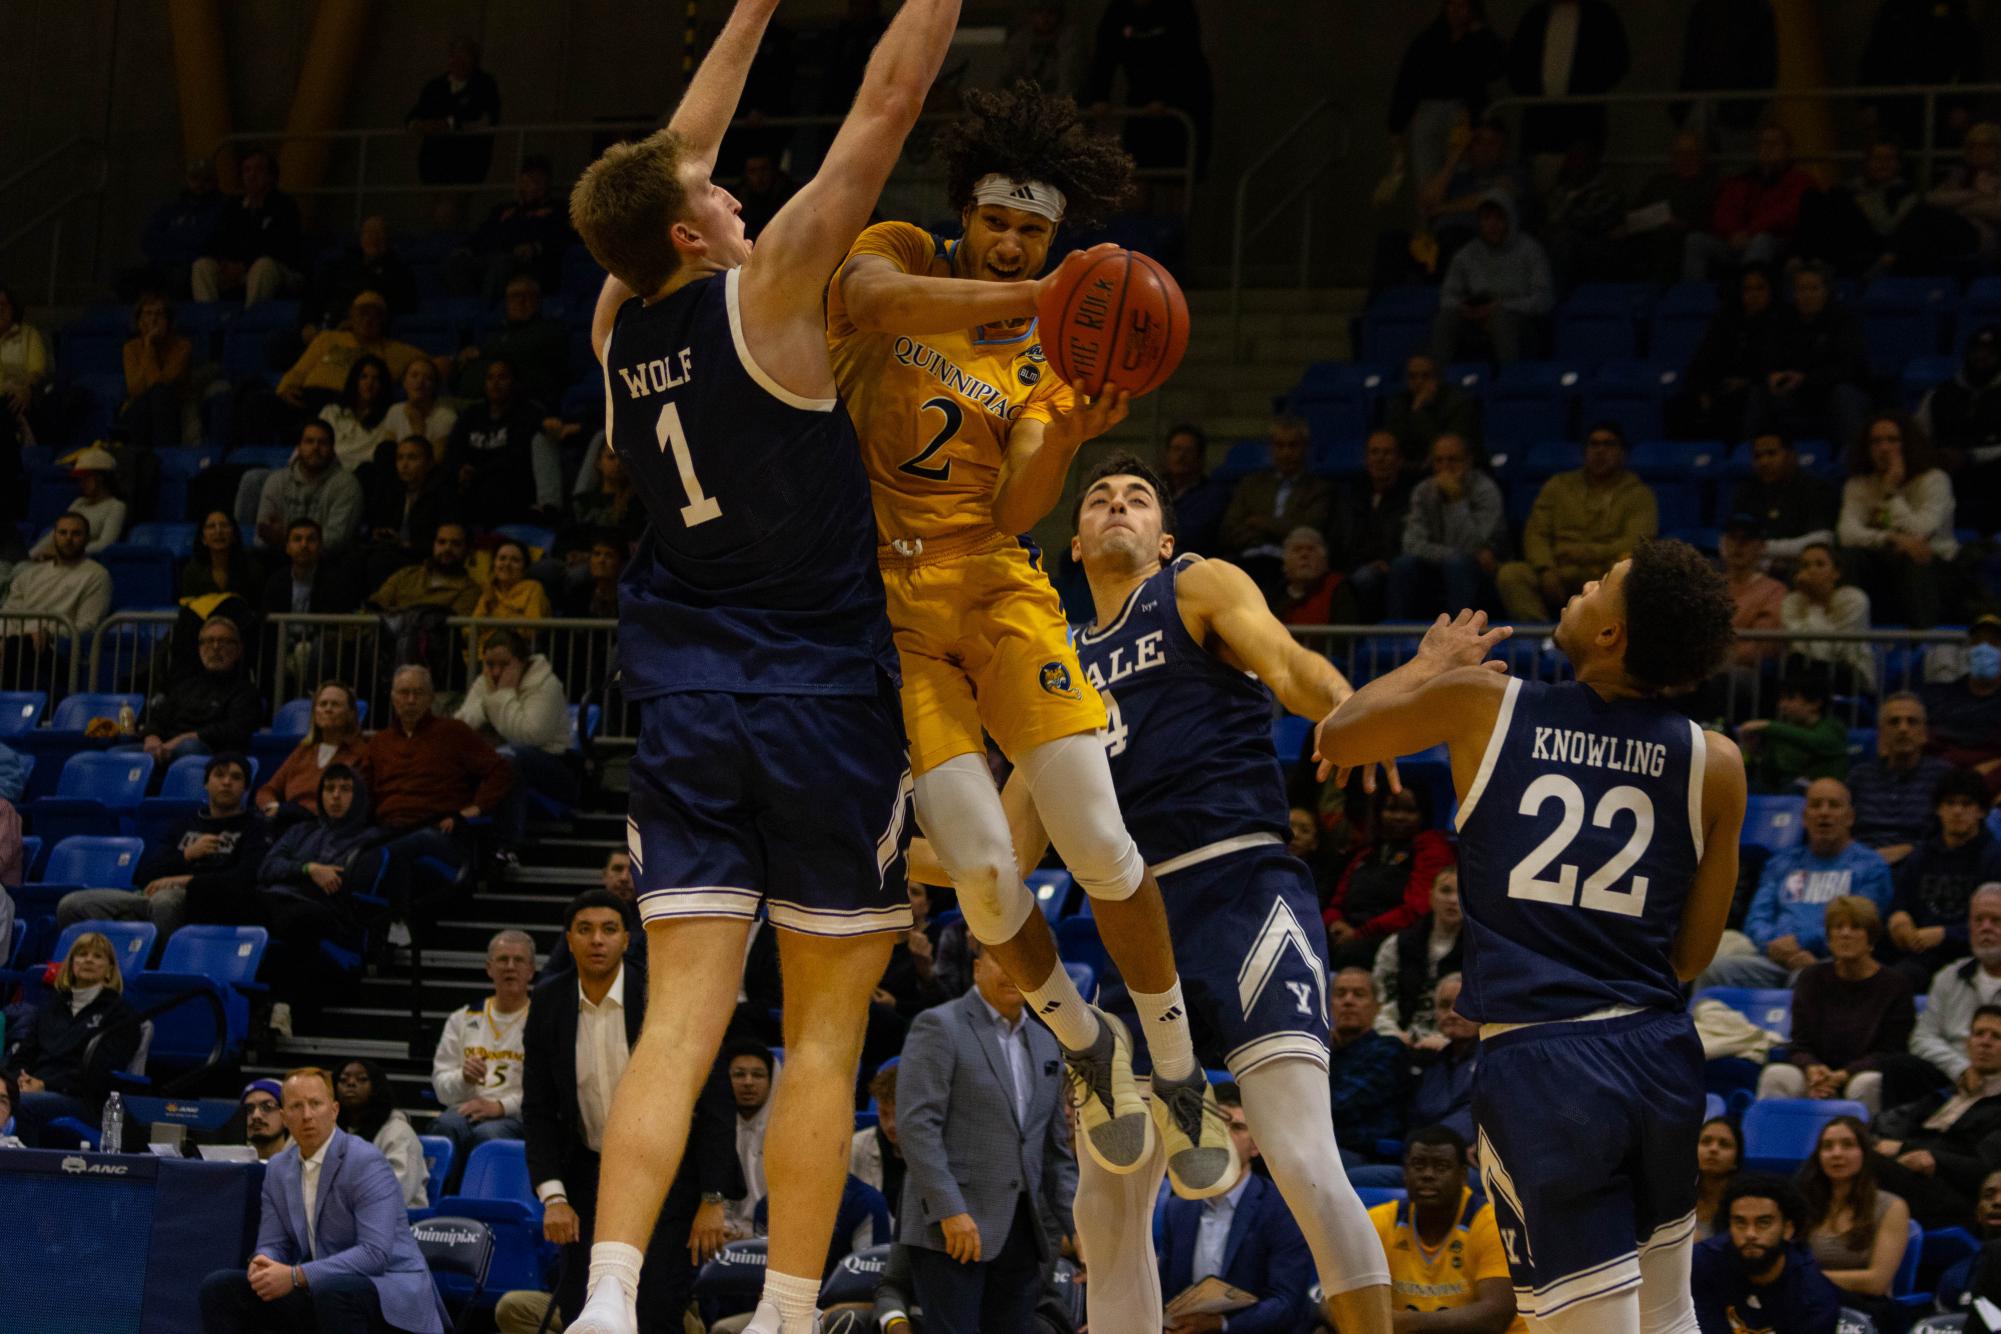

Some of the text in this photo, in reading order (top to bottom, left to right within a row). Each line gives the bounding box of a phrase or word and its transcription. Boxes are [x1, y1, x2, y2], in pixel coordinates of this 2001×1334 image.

[618, 347, 694, 399] WOLF
[893, 336, 1025, 421] QUINNIPIAC
[1020, 368, 1038, 381] BLM
[1070, 336, 1099, 378] THE
[655, 401, 724, 528] 1
[898, 396, 964, 481] 2
[1077, 629, 1167, 692] ALE
[1096, 688, 1128, 758] 4
[1532, 726, 1667, 778] KNOWLING
[1507, 773, 1655, 918] 22
[1803, 870, 1852, 904] NBA
[1284, 980, 1313, 1016] Y
[87, 1165, 129, 1175] ANC
[1500, 1227, 1522, 1265] Y
